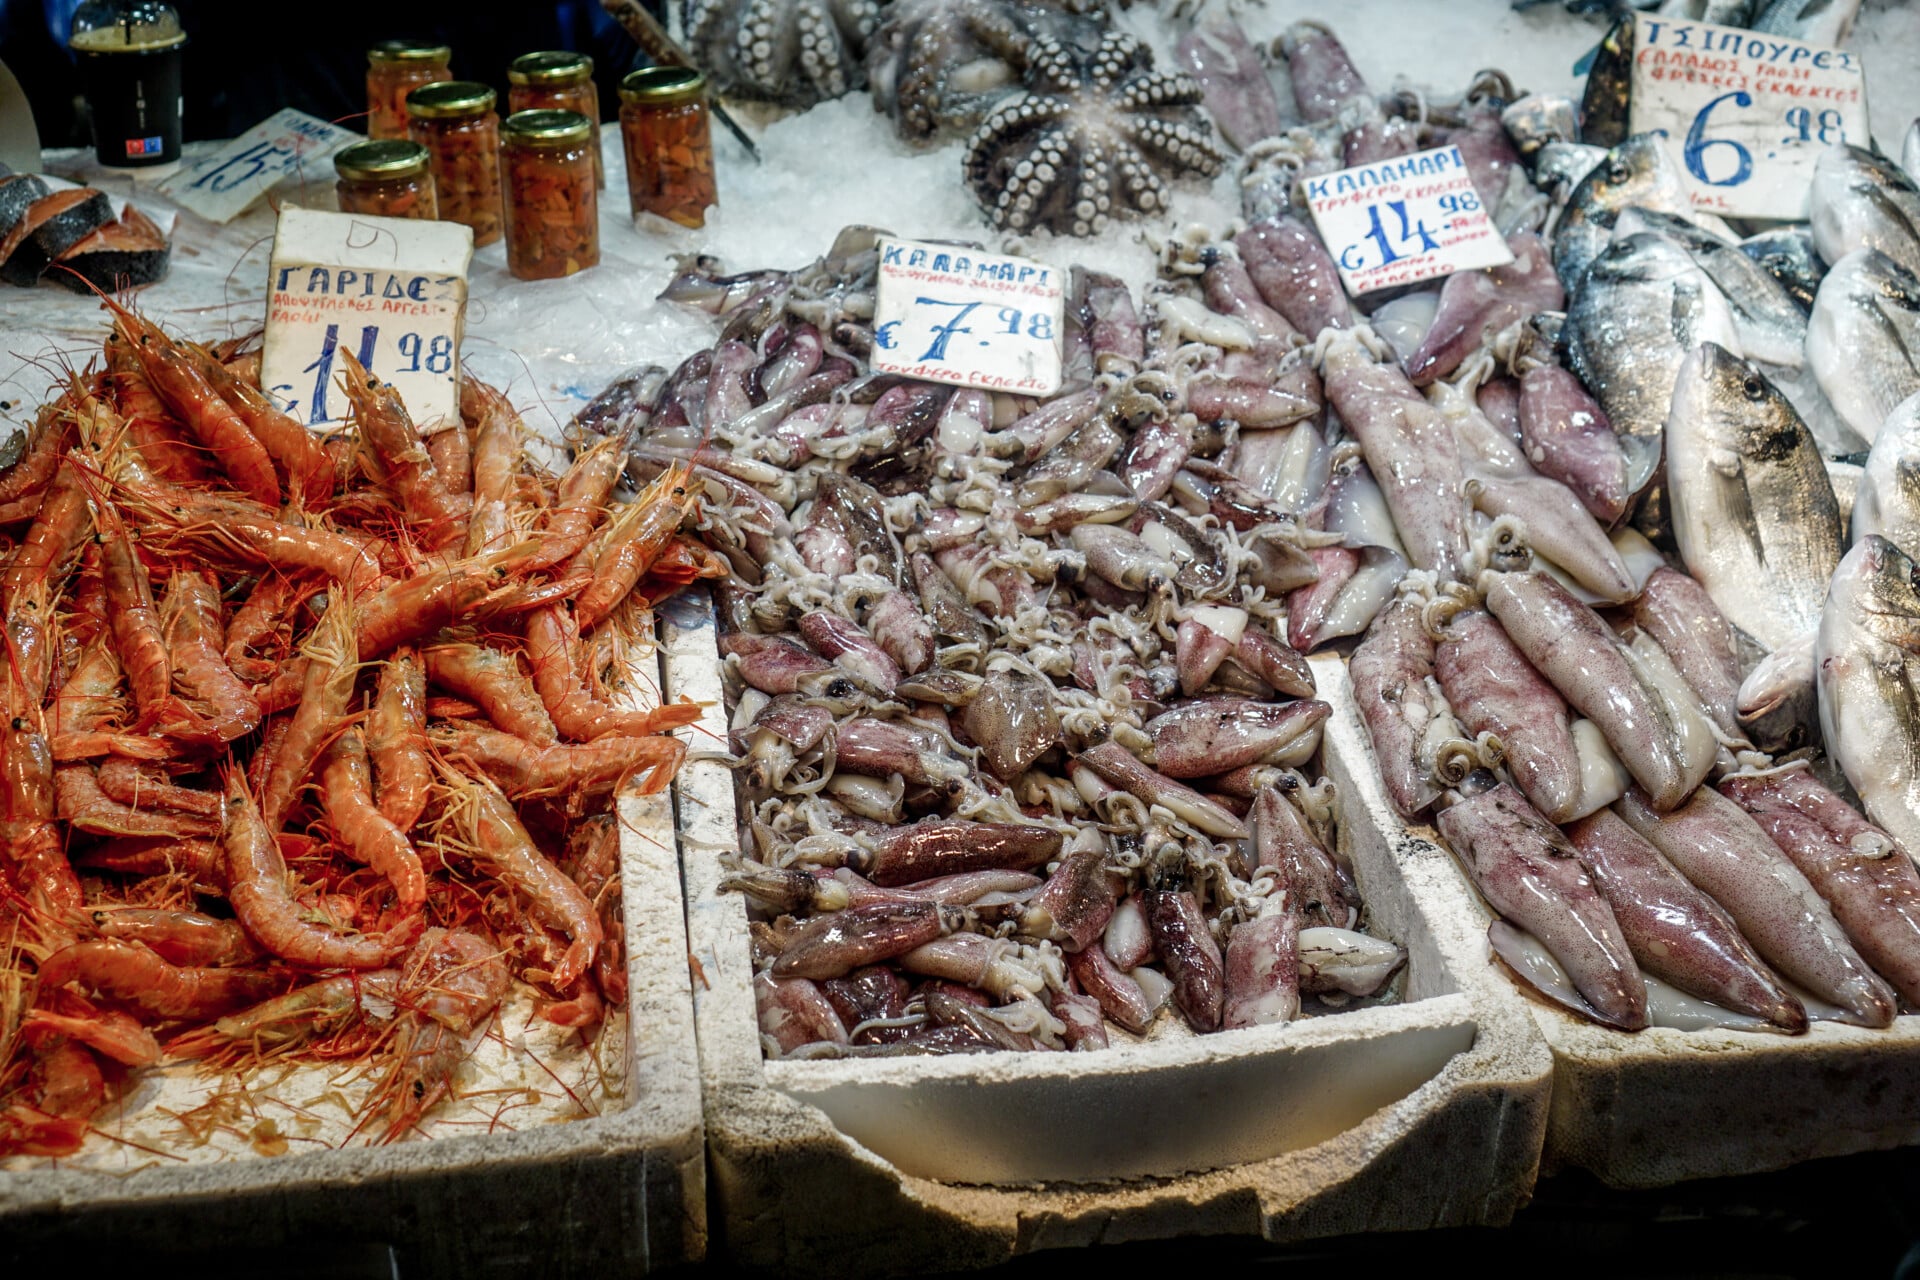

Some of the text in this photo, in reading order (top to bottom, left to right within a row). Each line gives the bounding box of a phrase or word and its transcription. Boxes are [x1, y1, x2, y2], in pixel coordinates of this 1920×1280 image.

[1637, 47, 1741, 73] ΕΛΛΑΔΟΣ
[1644, 20, 1860, 73] ΤΣΙΠΟΥΡΕΣ
[1309, 148, 1464, 201] ΚΑΛΑΜΑΡΙ
[1315, 183, 1401, 214] ΤΡΥΦΕΡΟ
[883, 244, 1052, 288] ΚΑΛΑΜΑΡΙ
[276, 267, 458, 302] ΓΑΡΙΔΕΣ
[874, 320, 903, 350] €
[877, 362, 963, 381] ΤΡΥΦΕΡΟ
